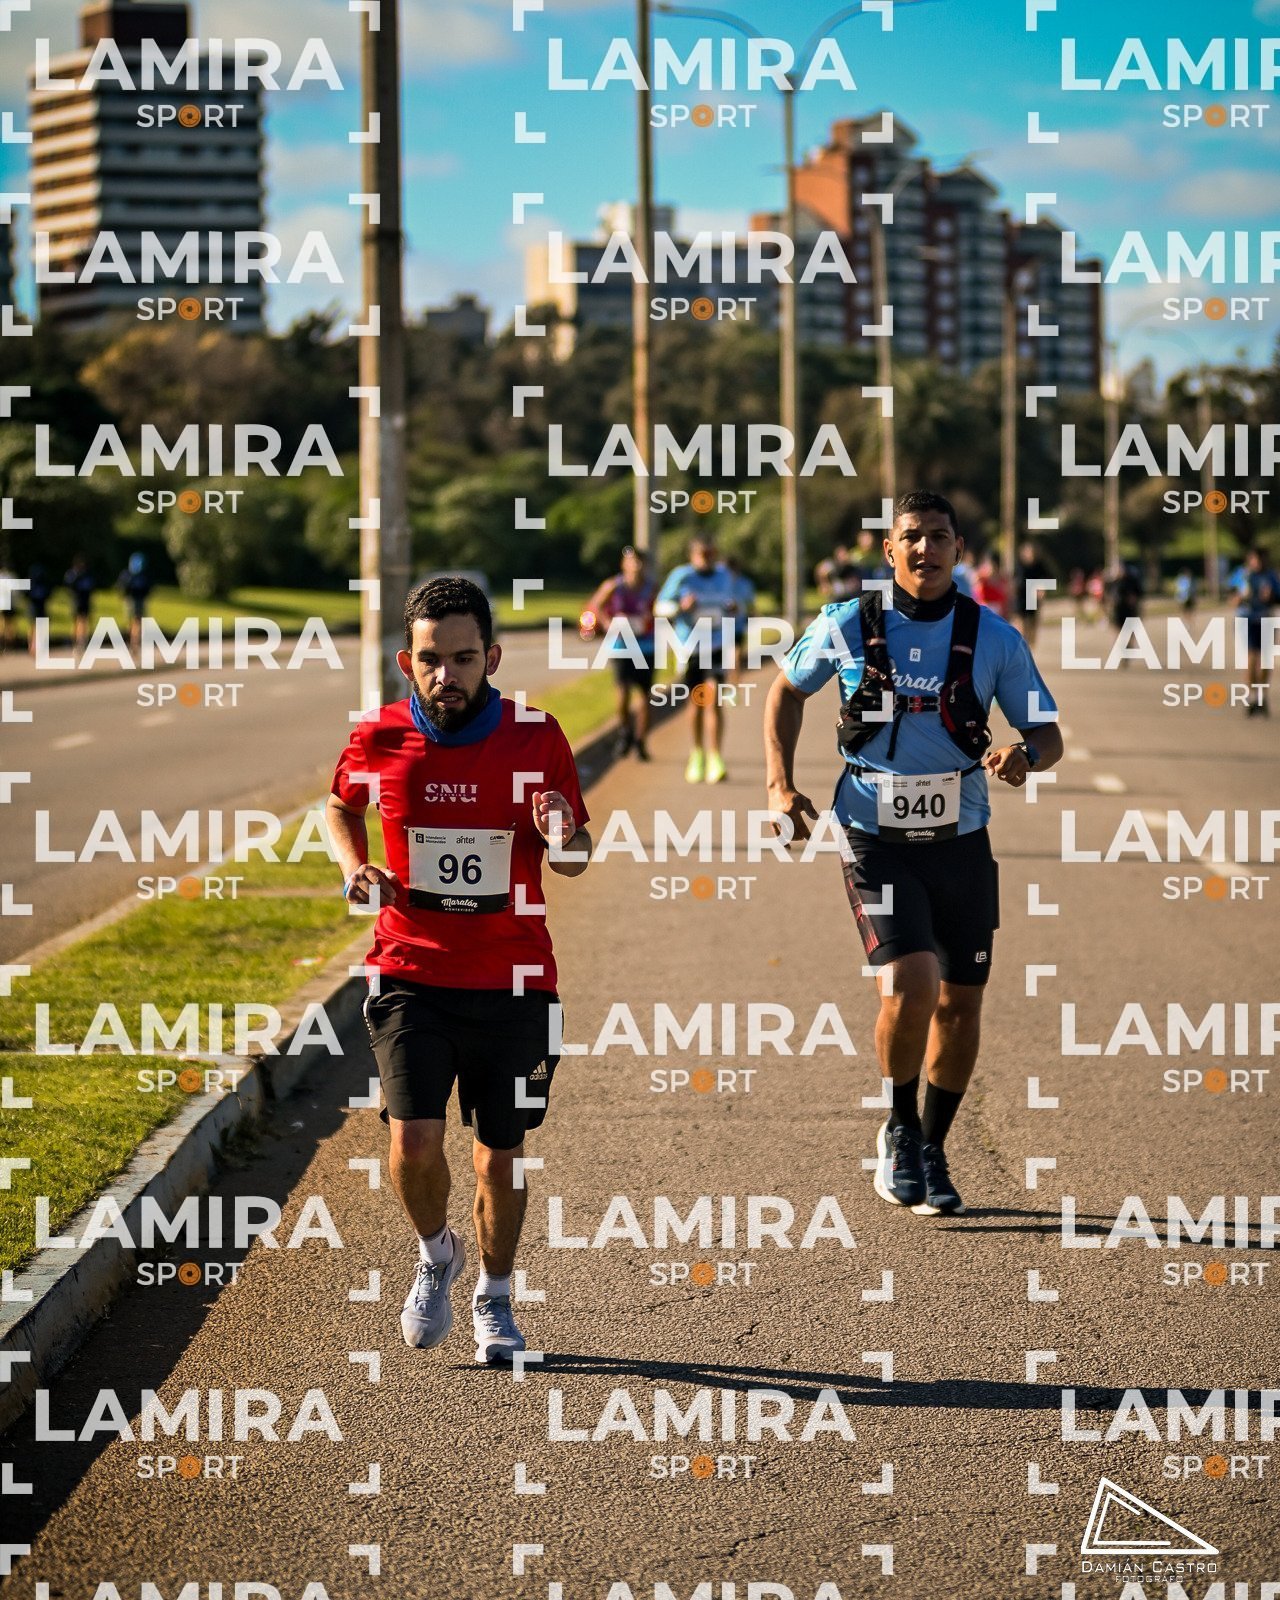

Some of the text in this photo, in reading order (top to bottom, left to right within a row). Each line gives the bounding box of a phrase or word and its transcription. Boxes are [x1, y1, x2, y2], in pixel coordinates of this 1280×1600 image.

[891, 673, 945, 694] arato
[424, 783, 478, 803] SNU
[892, 793, 945, 820] 940
[456, 835, 476, 844] antel
[438, 853, 482, 885] 96
[441, 898, 478, 908] Maratón
